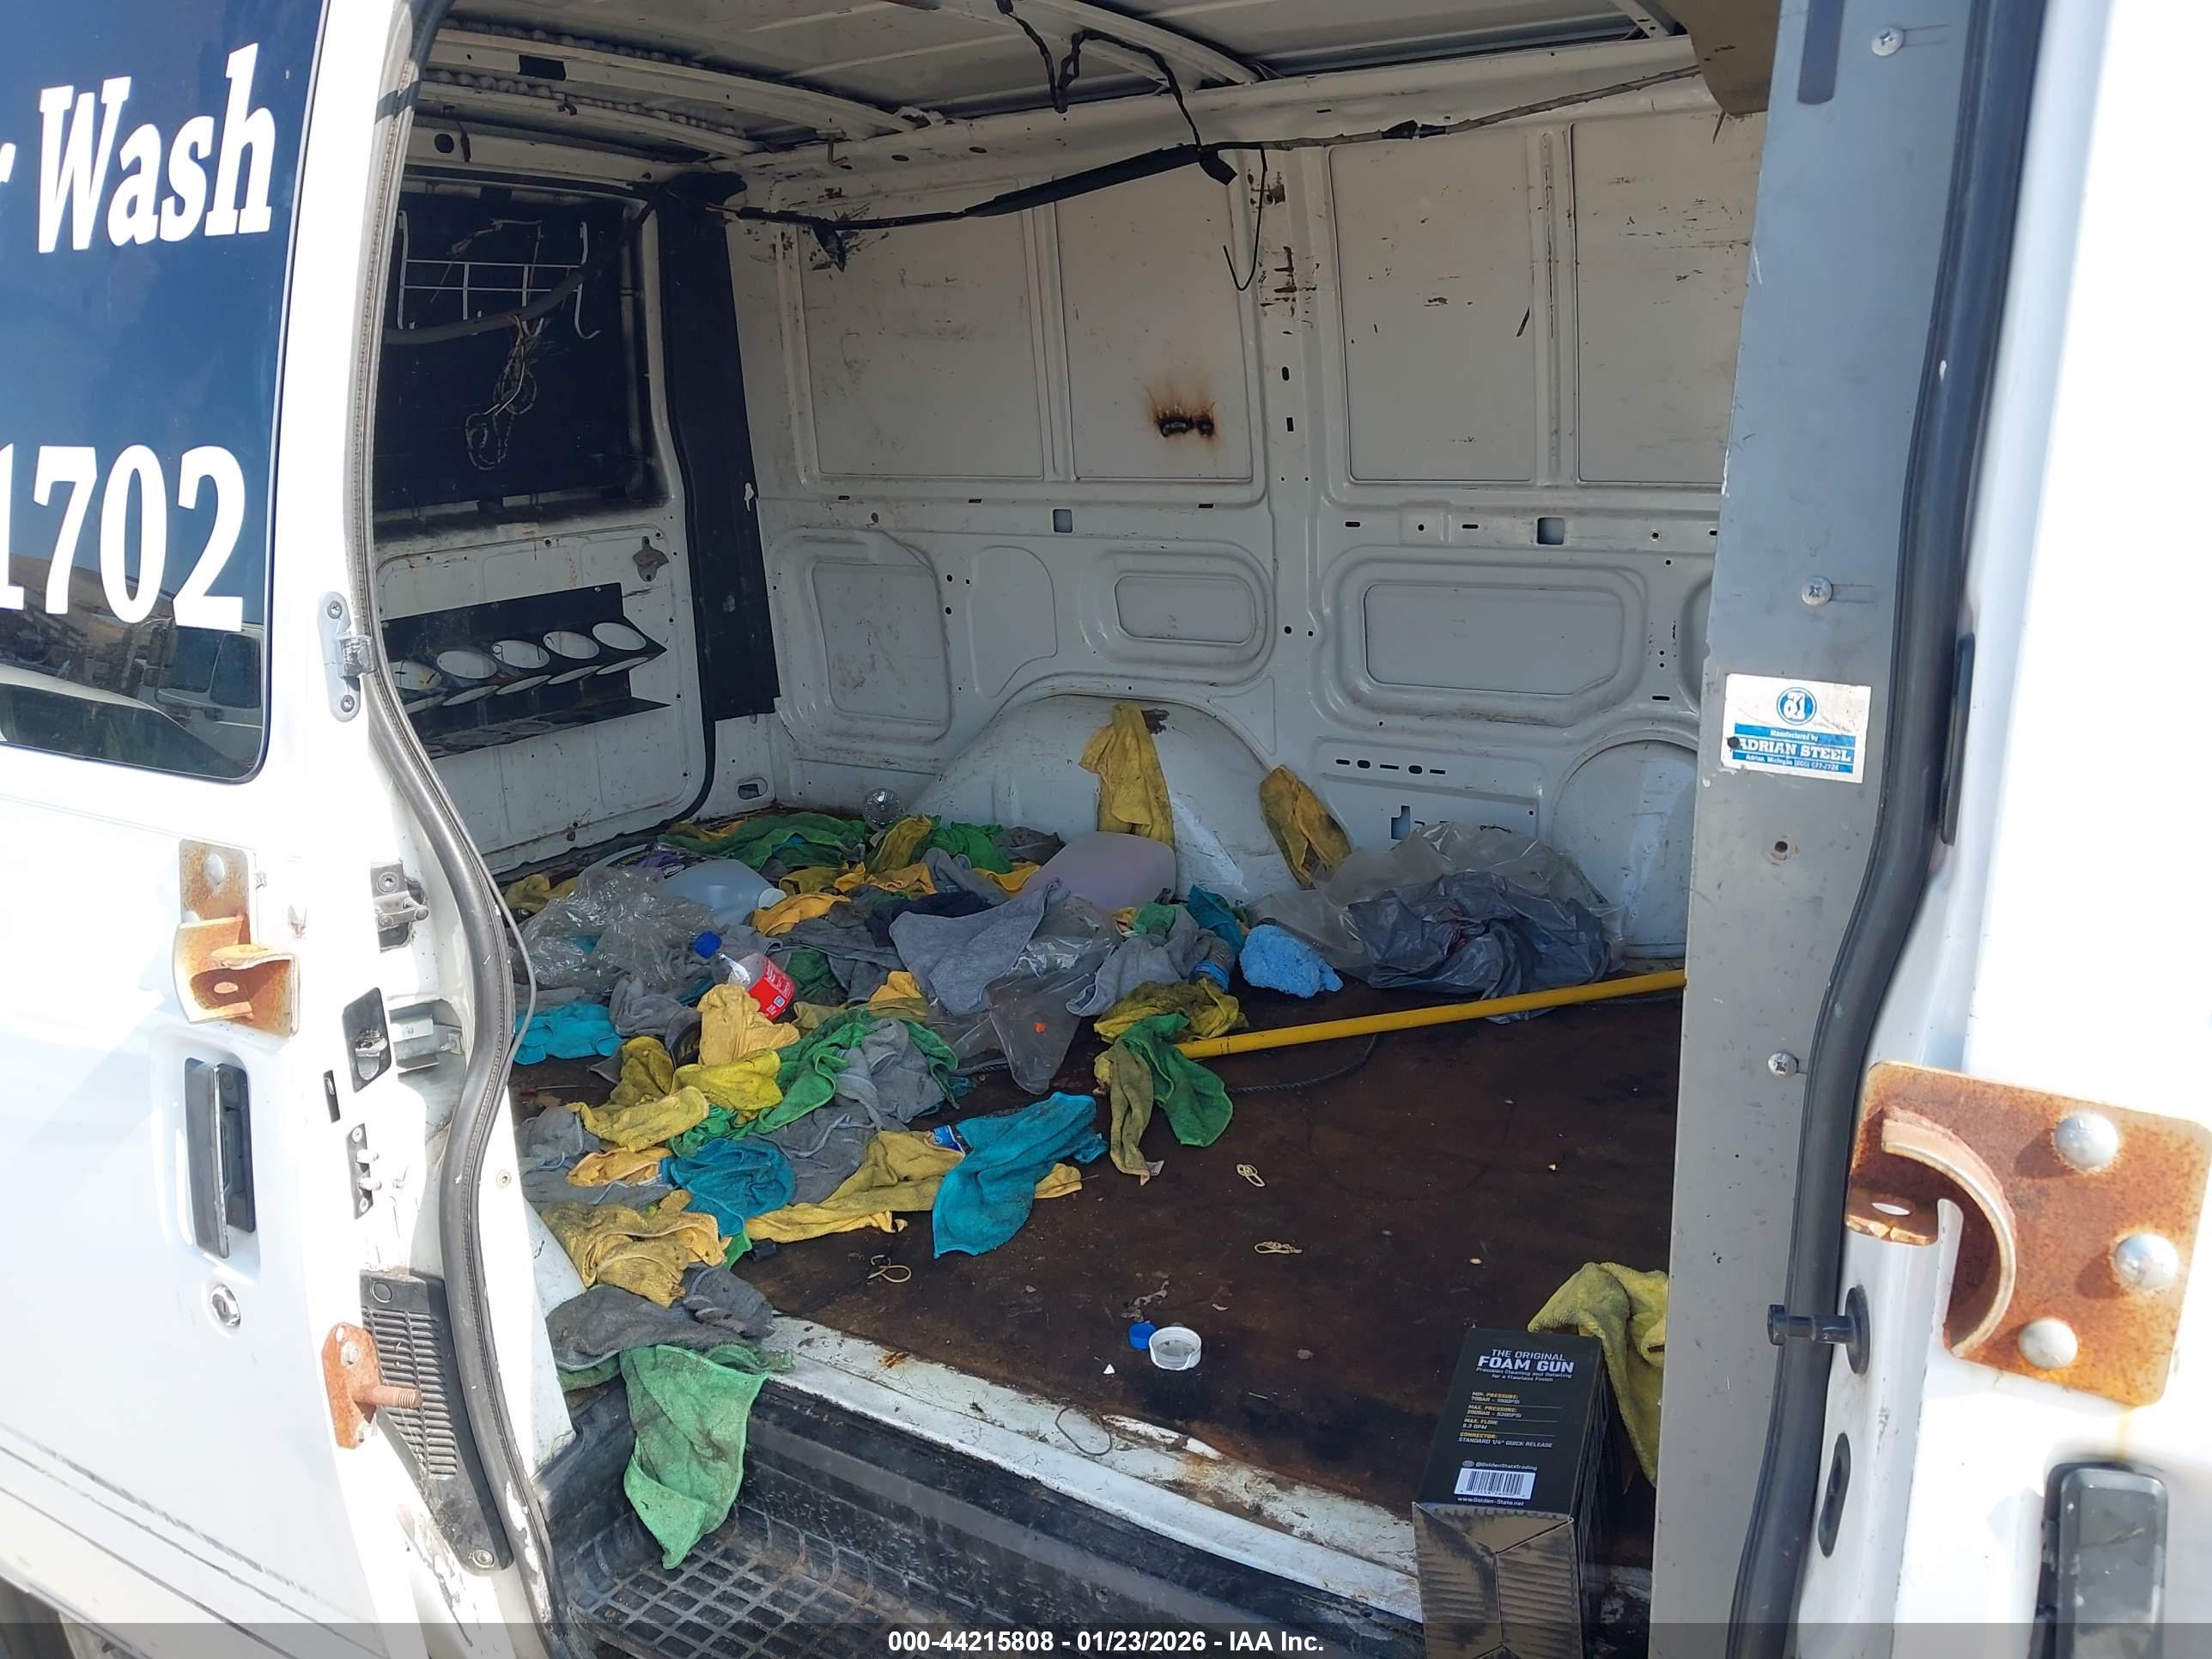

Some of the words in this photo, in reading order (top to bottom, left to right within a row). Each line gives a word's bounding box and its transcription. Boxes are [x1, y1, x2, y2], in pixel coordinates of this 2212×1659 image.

[39, 43, 276, 253] Wash
[1770, 728, 1811, 741] Manufactured
[1811, 733, 1820, 743] by
[1739, 738, 1797, 757] ADRIAN
[1800, 743, 1851, 764] STEEL
[1767, 755, 1793, 766] Michigan
[1492, 1349, 1512, 1358] THE
[1514, 1351, 1566, 1361] ORIGINAL
[1477, 1356, 1531, 1371] FOAM
[1536, 1360, 1575, 1373] GUN
